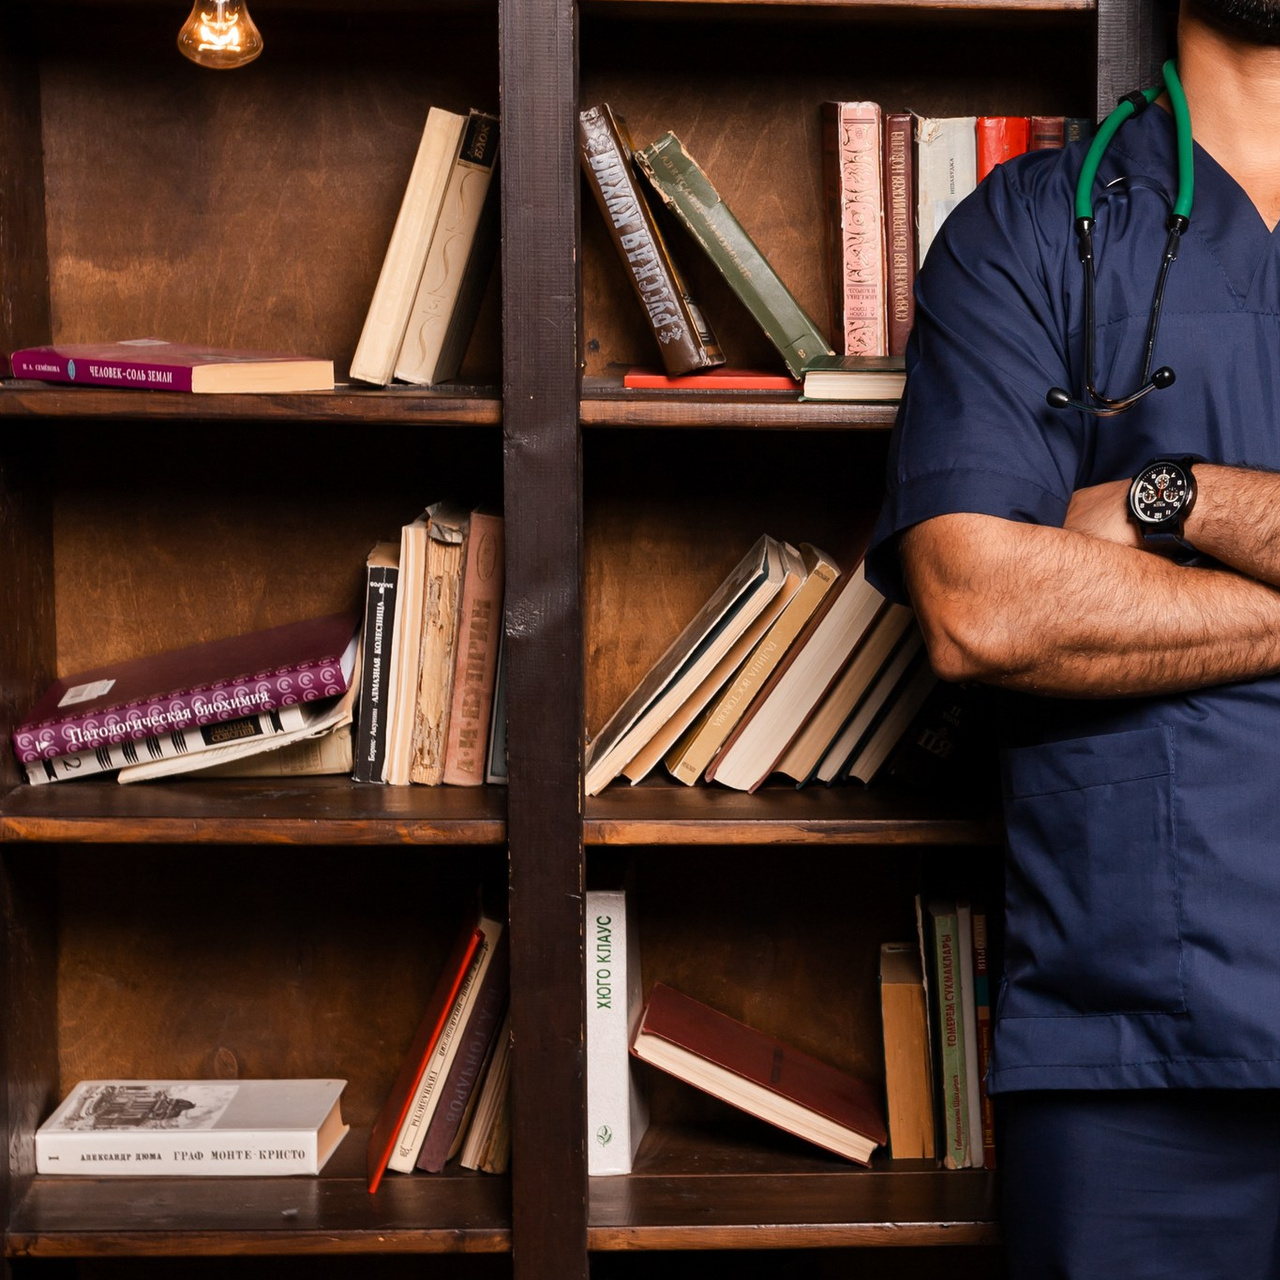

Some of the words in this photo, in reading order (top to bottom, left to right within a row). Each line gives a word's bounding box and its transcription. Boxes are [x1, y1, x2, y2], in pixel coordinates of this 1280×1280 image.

[468, 123, 495, 160] БЛОК
[890, 130, 905, 173] НОВЕЛЛА
[591, 149, 639, 229] КУХНЯ
[891, 175, 907, 250] АВСТРАЛИЙСКАЯ
[619, 228, 674, 330] РУССКАЯ
[893, 252, 909, 322] СОВРЕМЕННАЯ
[147, 370, 173, 383] ЗЕМЛИ
[373, 600, 384, 654] КОЛЕСНИЦА
[371, 657, 381, 702] АЛМАЗНАЯ
[746, 639, 777, 679] ГАЛИНА
[69, 702, 192, 745] Патологическая
[193, 686, 270, 718] биохимия
[368, 707, 379, 736] Акунин
[711, 675, 752, 729] ВОСТОКОВА
[366, 738, 378, 761] Борис
[596, 915, 611, 962] КЛАУС
[596, 968, 611, 1008] ХЮГО
[941, 933, 955, 1001] СУКМАКЛАРЫ
[477, 1008, 494, 1027] А.
[944, 1002, 957, 1047] ГОМЕРЕМ
[409, 1069, 438, 1128] ГИМНАЗИСТЫ
[444, 1028, 488, 1124] ГОНЧАРОВ
[80, 1152, 130, 1161] АЛЕКСАНДР
[135, 1152, 162, 1161] ДЮМА
[173, 1150, 204, 1161] ГРАФ
